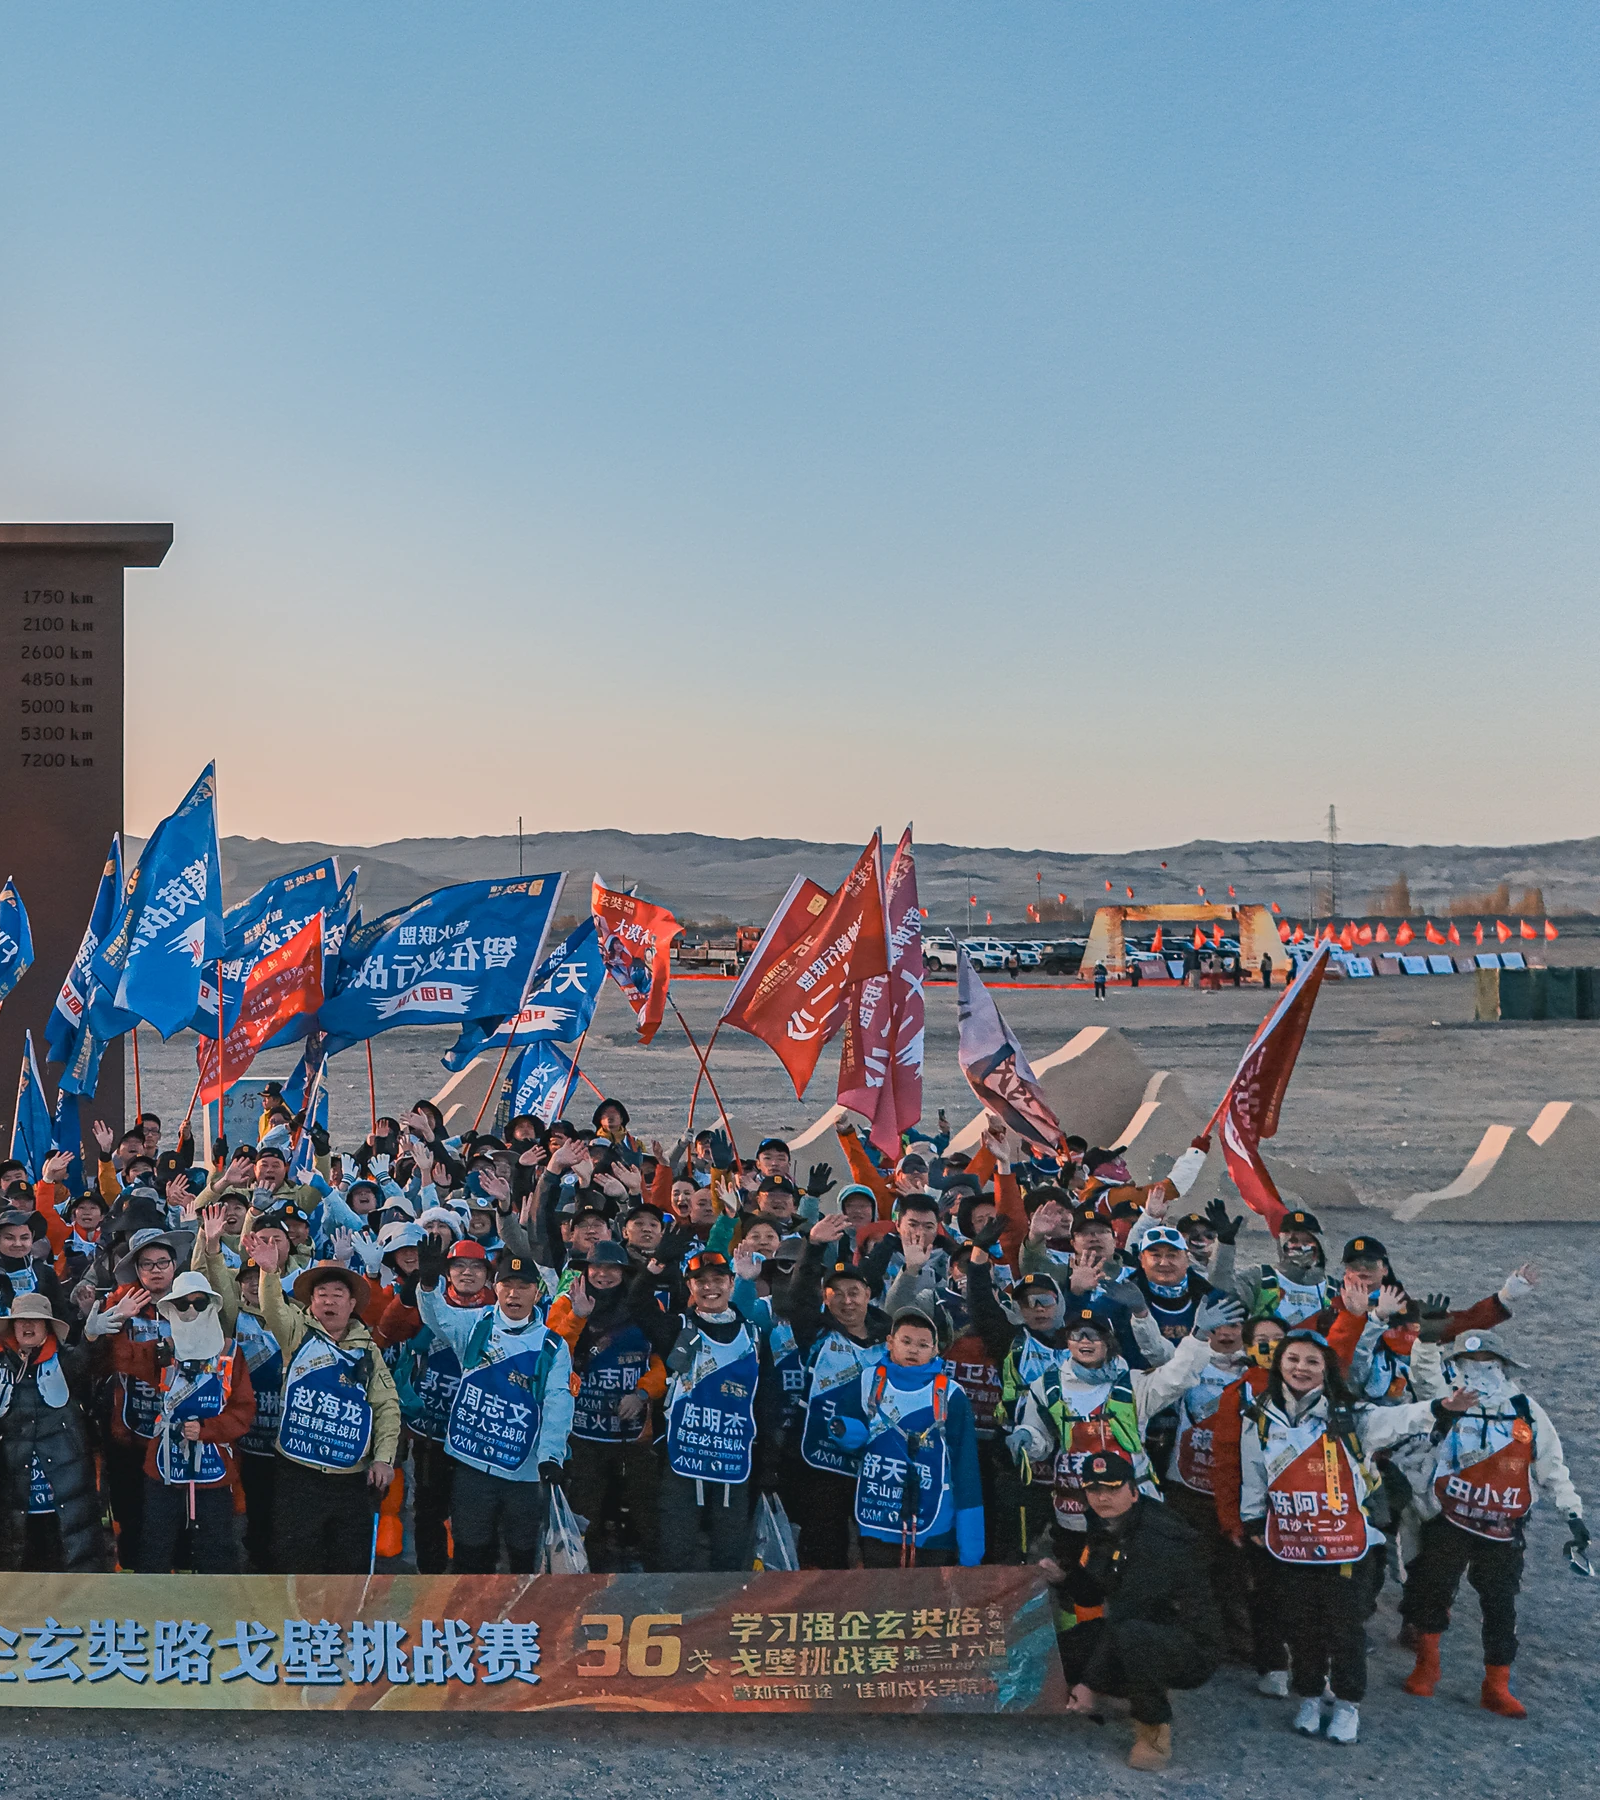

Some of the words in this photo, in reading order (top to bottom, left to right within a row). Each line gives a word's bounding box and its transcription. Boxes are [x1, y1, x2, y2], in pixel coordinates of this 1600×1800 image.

[24, 590, 65, 605] 1750
[71, 590, 93, 606] km
[24, 617, 65, 632] 2100
[71, 617, 93, 633] km
[22, 645, 65, 660] 2600
[71, 645, 93, 661] km
[22, 672, 65, 687] 4850
[71, 672, 93, 688] km
[22, 699, 65, 714] 5000
[71, 699, 93, 715] km
[22, 726, 65, 741] 5300
[71, 726, 93, 742] km
[22, 753, 65, 768] 7200
[71, 753, 93, 769] km
[599, 893, 624, 910] 玄奘
[291, 1385, 362, 1426] 赵海龙
[461, 1383, 532, 1428] 周志文
[288, 1411, 361, 1441] 坤道精英战队
[456, 1407, 526, 1444] 宏才人文战队
[681, 1402, 747, 1435] 陈明杰
[285, 1437, 314, 1454] AXM
[452, 1433, 477, 1452] AXM
[676, 1426, 746, 1450] 智在必行战队
[674, 1454, 703, 1471] AXM
[811, 1450, 843, 1467] AXM
[1448, 1475, 1522, 1509] 田小红
[860, 1508, 882, 1522] AXM
[1278, 1518, 1347, 1533] 风沙十二少
[1280, 1545, 1307, 1559] AXM
[729, 1608, 985, 1644] 学习强企玄奘路
[576, 1613, 684, 1677] 36
[730, 1646, 900, 1678] 戈壁挑战赛
